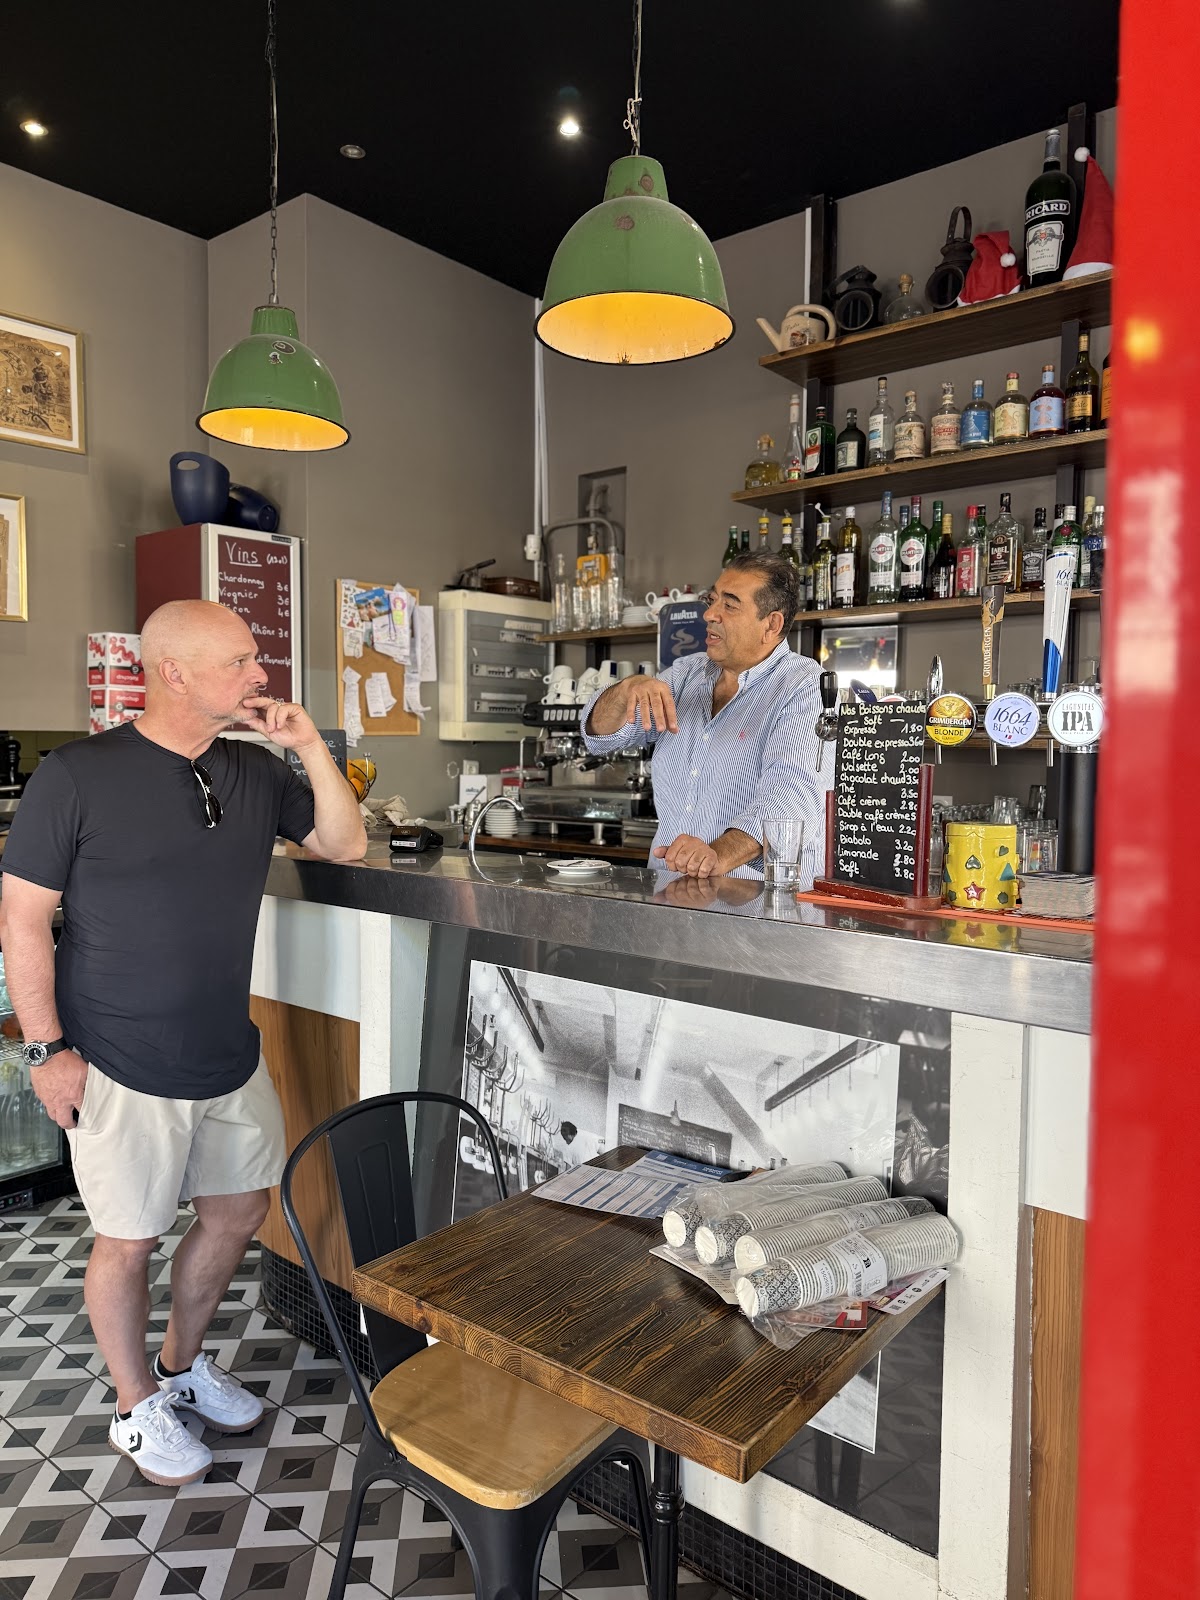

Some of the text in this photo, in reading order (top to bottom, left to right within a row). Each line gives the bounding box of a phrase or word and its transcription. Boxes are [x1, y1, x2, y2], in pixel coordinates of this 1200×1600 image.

[1026, 203, 1067, 220] RICARD
[225, 541, 258, 564] Vins
[991, 545, 1010, 555] LABEL
[996, 552, 1003, 560] 5
[218, 572, 289, 592] Chardonnay 3€
[277, 607, 290, 617] 4€
[670, 610, 698, 620] LAVAZZA
[251, 622, 275, 636] Rhône
[983, 627, 992, 678] GRIMBERGEN
[840, 704, 857, 716] Nos
[859, 702, 893, 716] Boissons
[992, 706, 1033, 726] 1664
[863, 714, 883, 725] Soft
[928, 716, 972, 726] GRIMBERGEN
[1061, 711, 1094, 732] IPA
[901, 723, 923, 734] 1.80
[934, 728, 964, 737] BLONDE
[993, 723, 1029, 736] BLANC
[843, 737, 872, 748] Double
[841, 748, 862, 766] Café
[841, 763, 919, 774] Noisette 2.00
[880, 771, 906, 785] chaud
[838, 783, 856, 793] Thé
[837, 795, 857, 810] Café
[859, 796, 887, 806] crème
[837, 808, 862, 819] Double
[864, 808, 884, 824] café
[839, 820, 859, 835] Sirop
[860, 823, 867, 832] à
[870, 821, 895, 832] l'eau
[840, 834, 914, 852] Diabolo 3.20
[838, 844, 880, 860] Limonade
[839, 858, 915, 881] Soft 3.80
